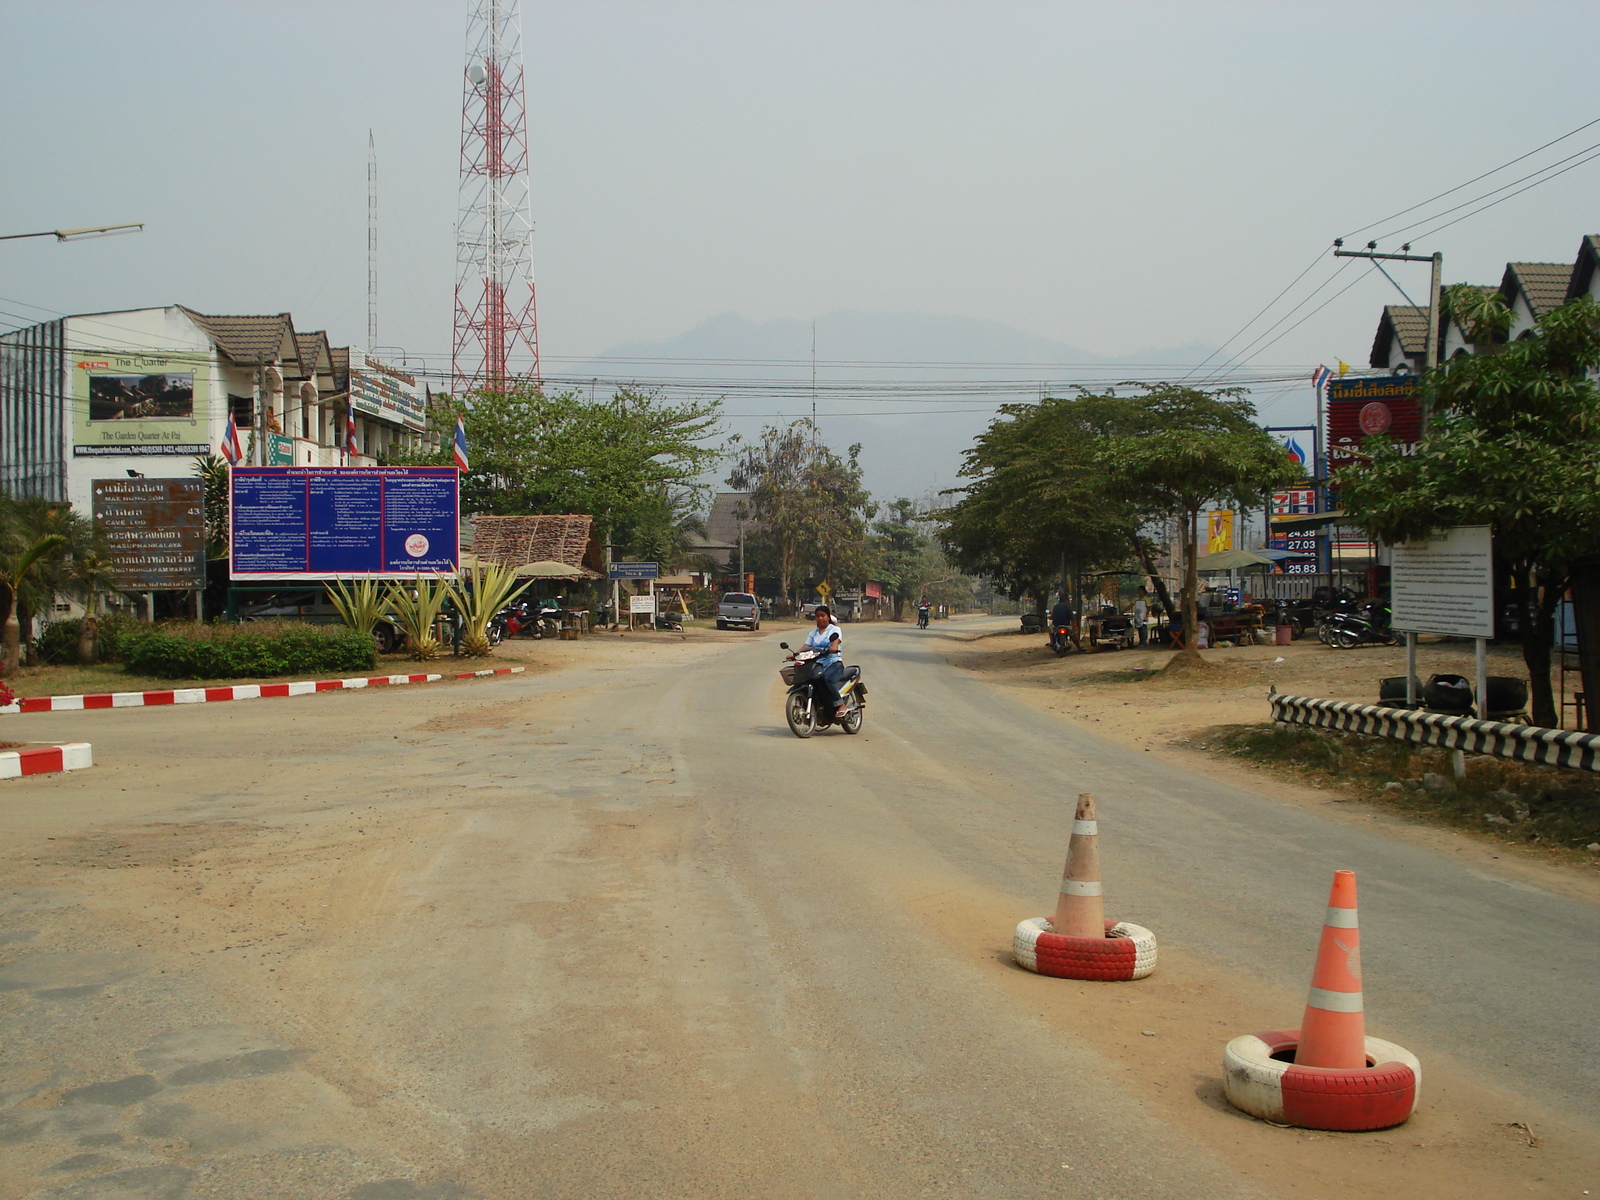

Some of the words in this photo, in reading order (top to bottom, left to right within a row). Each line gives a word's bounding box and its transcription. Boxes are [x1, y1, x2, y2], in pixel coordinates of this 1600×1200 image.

[115, 359, 132, 367] The
[134, 357, 168, 369] Quarter
[102, 431, 114, 440] The
[115, 431, 137, 440] Garden
[138, 431, 161, 442] Quarter
[163, 431, 171, 440] At
[172, 431, 181, 440] Pai
[183, 484, 200, 492] 111
[187, 507, 200, 515] 43
[193, 531, 200, 539] 3
[1288, 529, 1316, 538] 24.38
[1288, 541, 1316, 550] 27.03
[1288, 564, 1317, 574] 25.83
